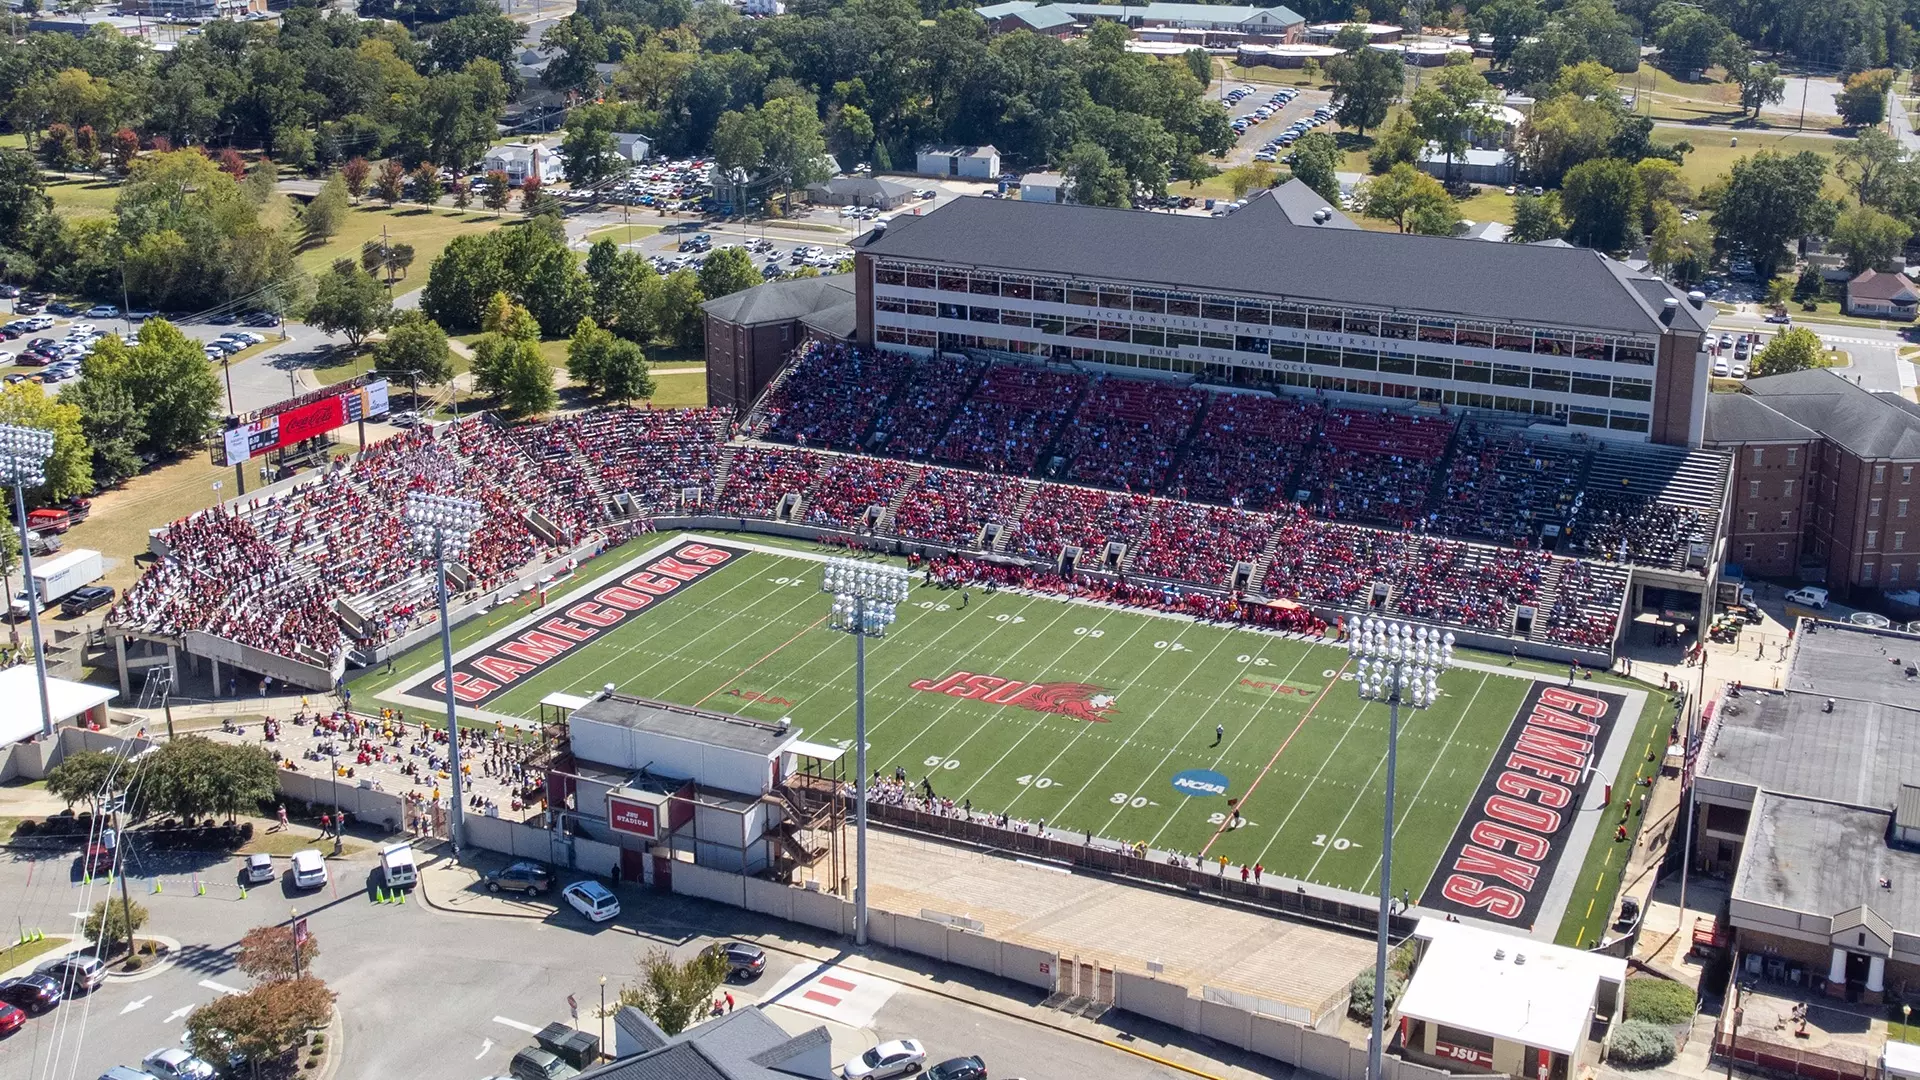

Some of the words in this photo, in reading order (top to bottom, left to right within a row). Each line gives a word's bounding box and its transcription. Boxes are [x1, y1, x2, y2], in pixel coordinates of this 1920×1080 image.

[1087, 309, 1209, 329] JACKSONVILLE
[1223, 324, 1274, 336] STATE
[1291, 331, 1400, 350] UNIVERSITY
[1149, 348, 1180, 358] HOME
[1188, 352, 1202, 360] OF
[1211, 355, 1232, 363] THE
[1241, 358, 1314, 373] GAMECOCKS
[431, 544, 733, 702] GAMECOCKS
[909, 671, 1044, 706] JSU
[923, 755, 960, 770] 50
[1016, 774, 1052, 789] 40
[1174, 778, 1226, 794] NCAA
[1109, 792, 1148, 808] 30
[1441, 686, 1609, 920] GAMECOCKS
[616, 815, 649, 828] STADIUM
[625, 811, 639, 819] JSU
[1206, 812, 1247, 829] 20
[1311, 833, 1351, 850] 10
[1450, 1046, 1479, 1062] JSU
